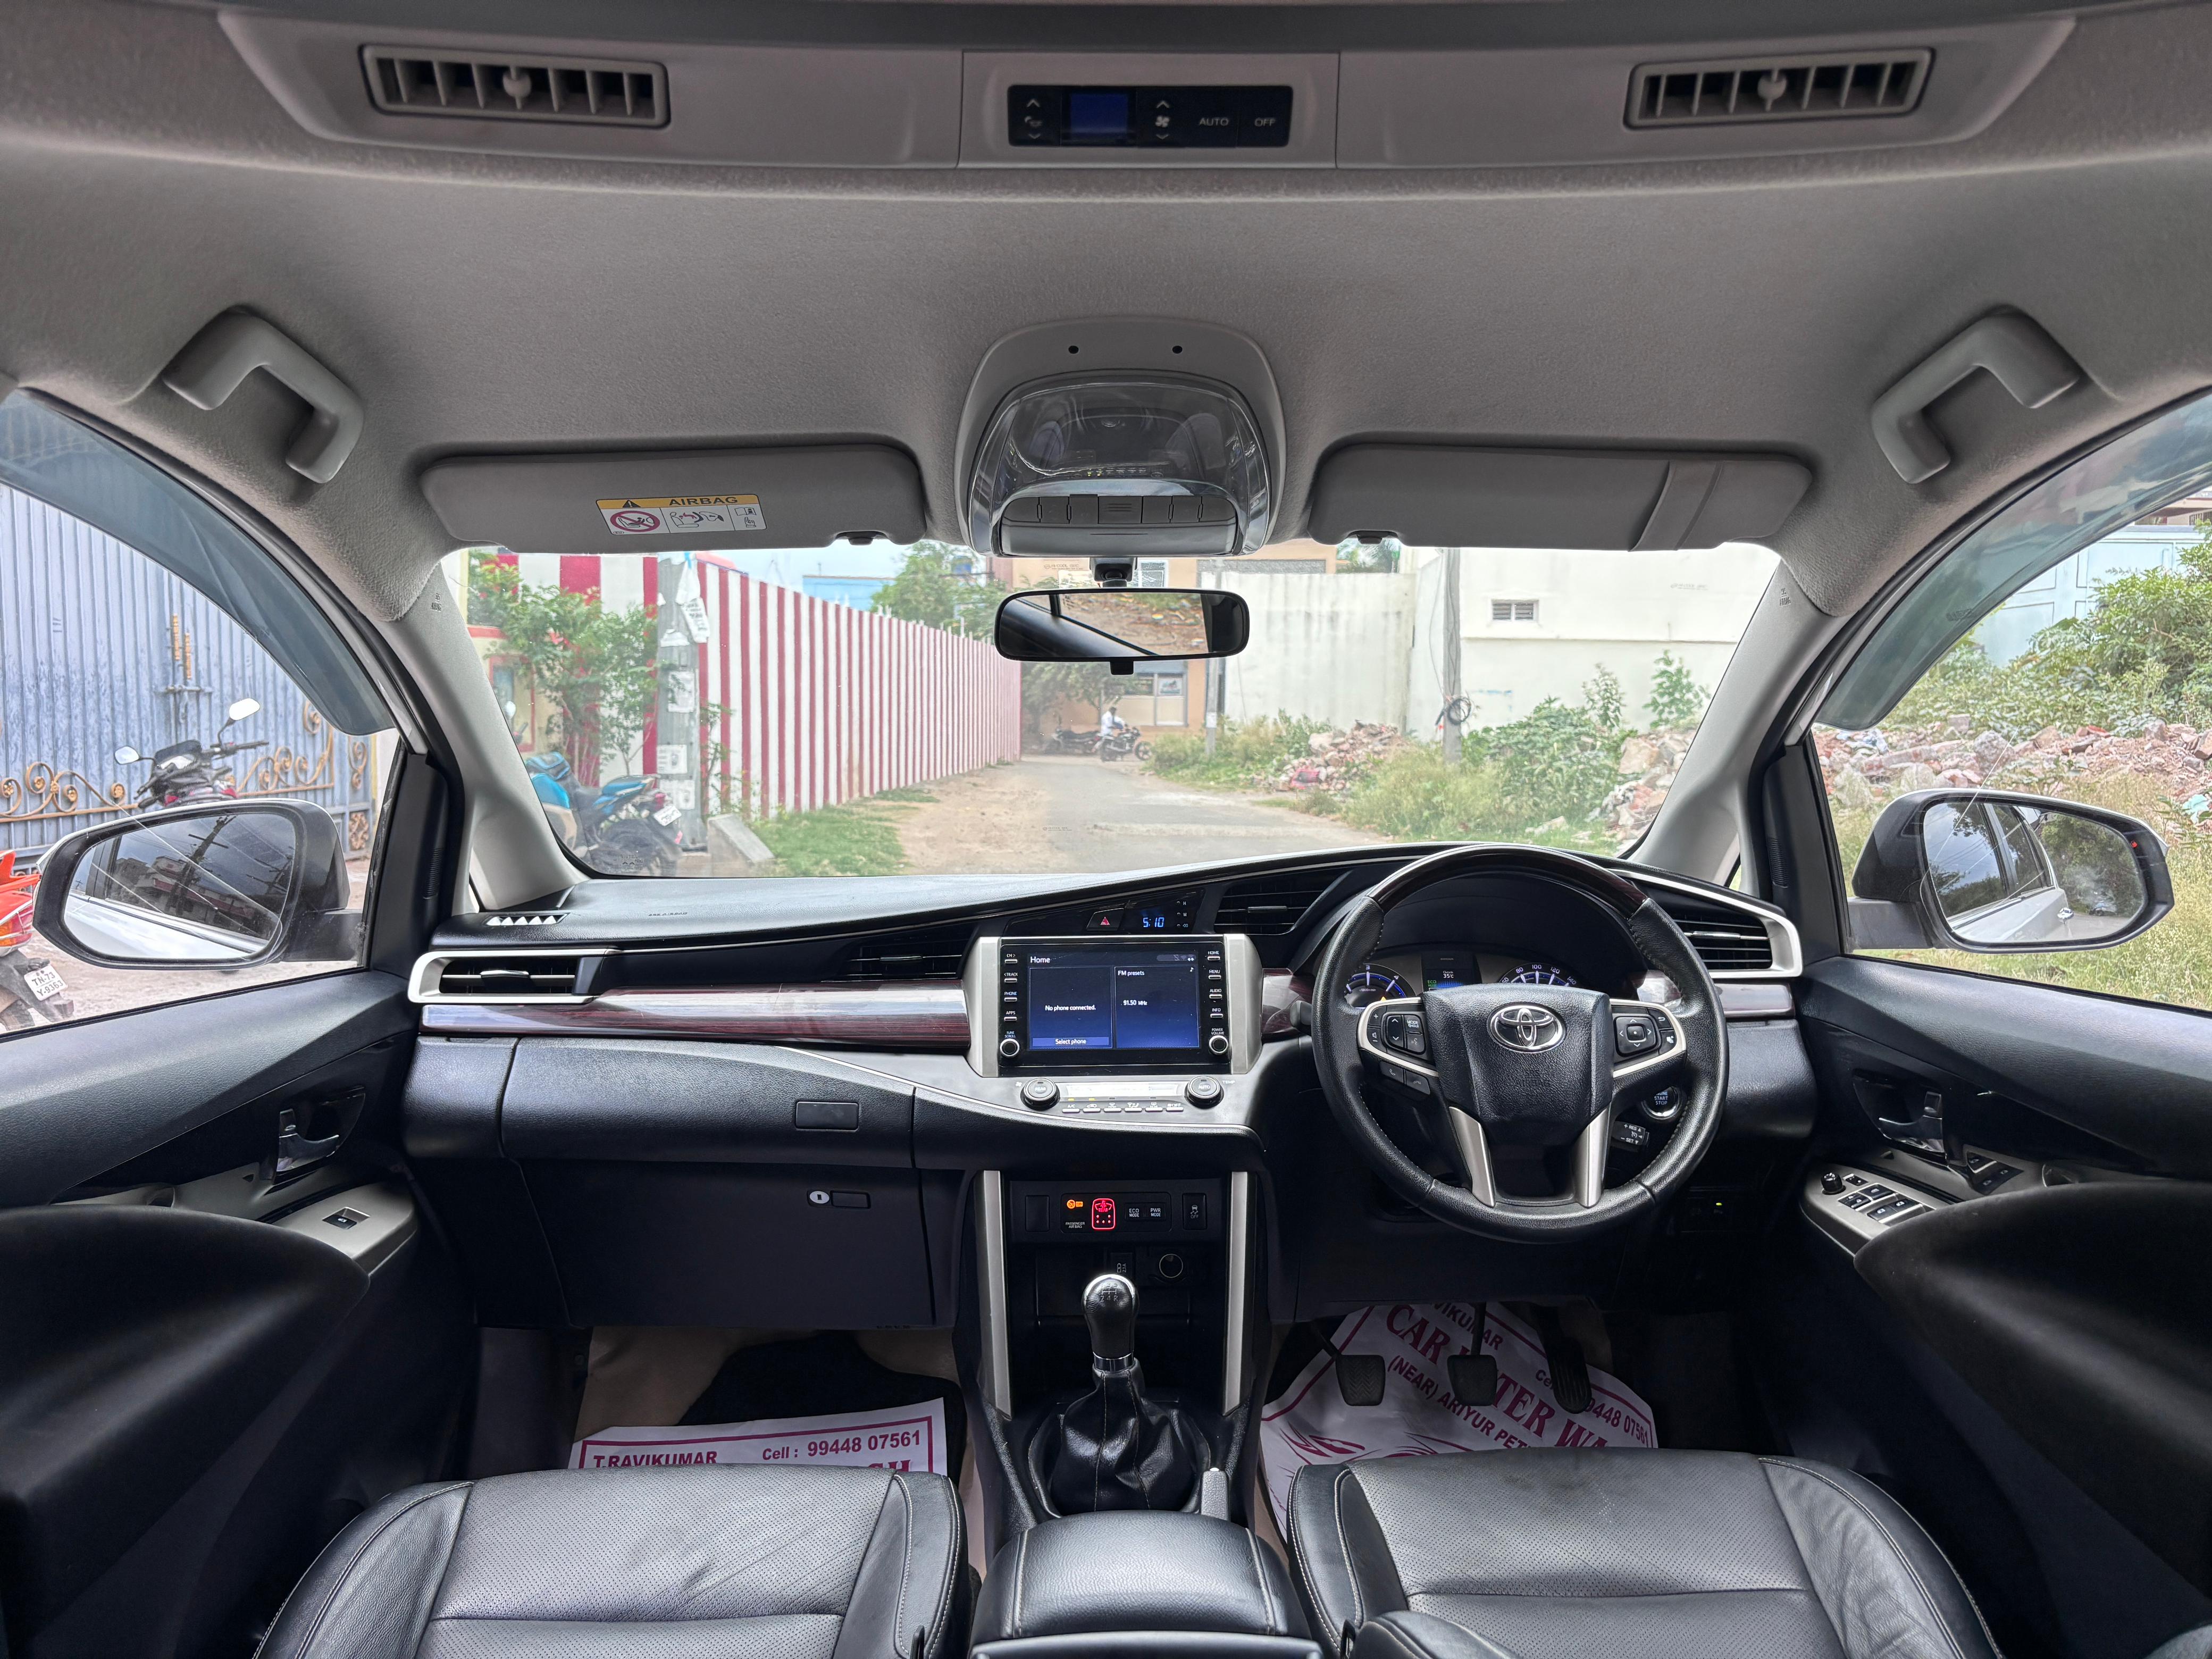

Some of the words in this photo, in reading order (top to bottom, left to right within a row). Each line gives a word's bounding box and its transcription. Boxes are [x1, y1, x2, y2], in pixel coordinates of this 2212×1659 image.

[1199, 117, 1228, 127] AUTO
[1254, 118, 1276, 127] OFF
[669, 497, 738, 506] AIRBAG
[1143, 917, 1164, 928] 5:10
[1567, 976, 1577, 985] 140
[1386, 1304, 1451, 1365] CAR
[1387, 1355, 1438, 1400] (NEAR)
[1437, 1392, 1495, 1436] ARIYUR
[1623, 1415, 1649, 1448] 07561
[593, 1451, 718, 1468] T.RAVIKUMAR
[762, 1446, 790, 1460] Cell
[807, 1437, 862, 1457] 99448
[867, 1429, 920, 1451] 07561
